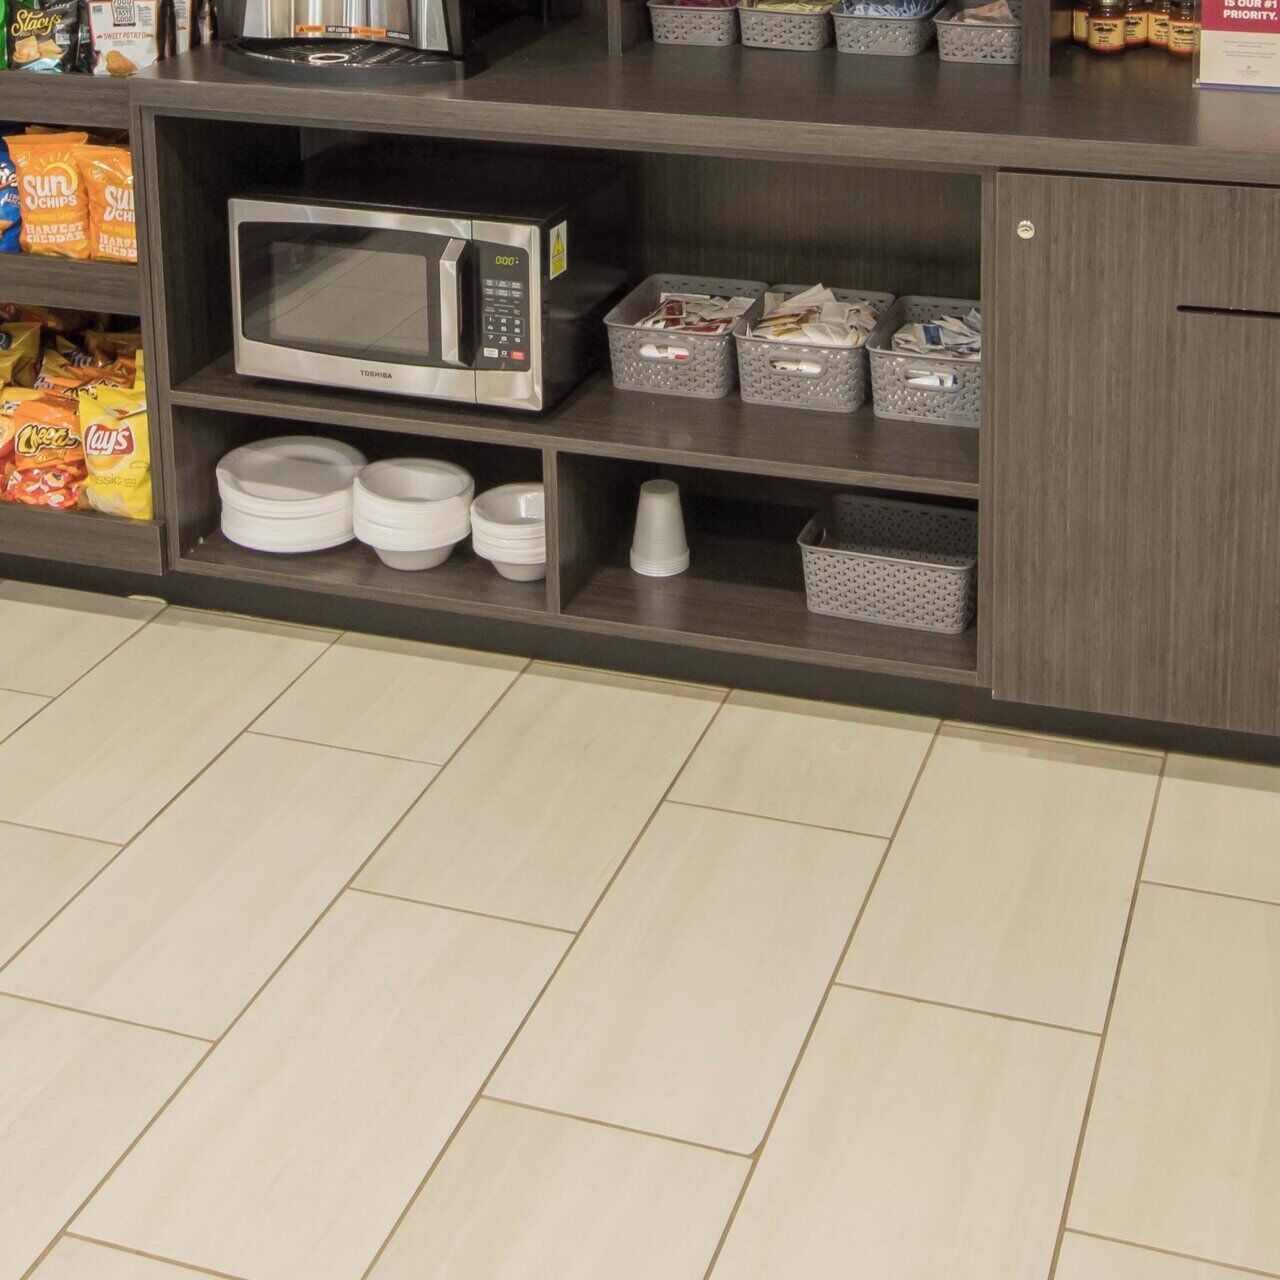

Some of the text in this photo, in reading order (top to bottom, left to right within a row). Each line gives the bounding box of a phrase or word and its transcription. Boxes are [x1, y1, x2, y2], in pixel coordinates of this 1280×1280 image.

[1223, 9, 1278, 21] PRIORITY.
[11, 10, 61, 37] Stacy's
[39, 196, 77, 208] CHIPS
[360, 370, 392, 379] TOSHIBA
[87, 425, 131, 454] Lay's
